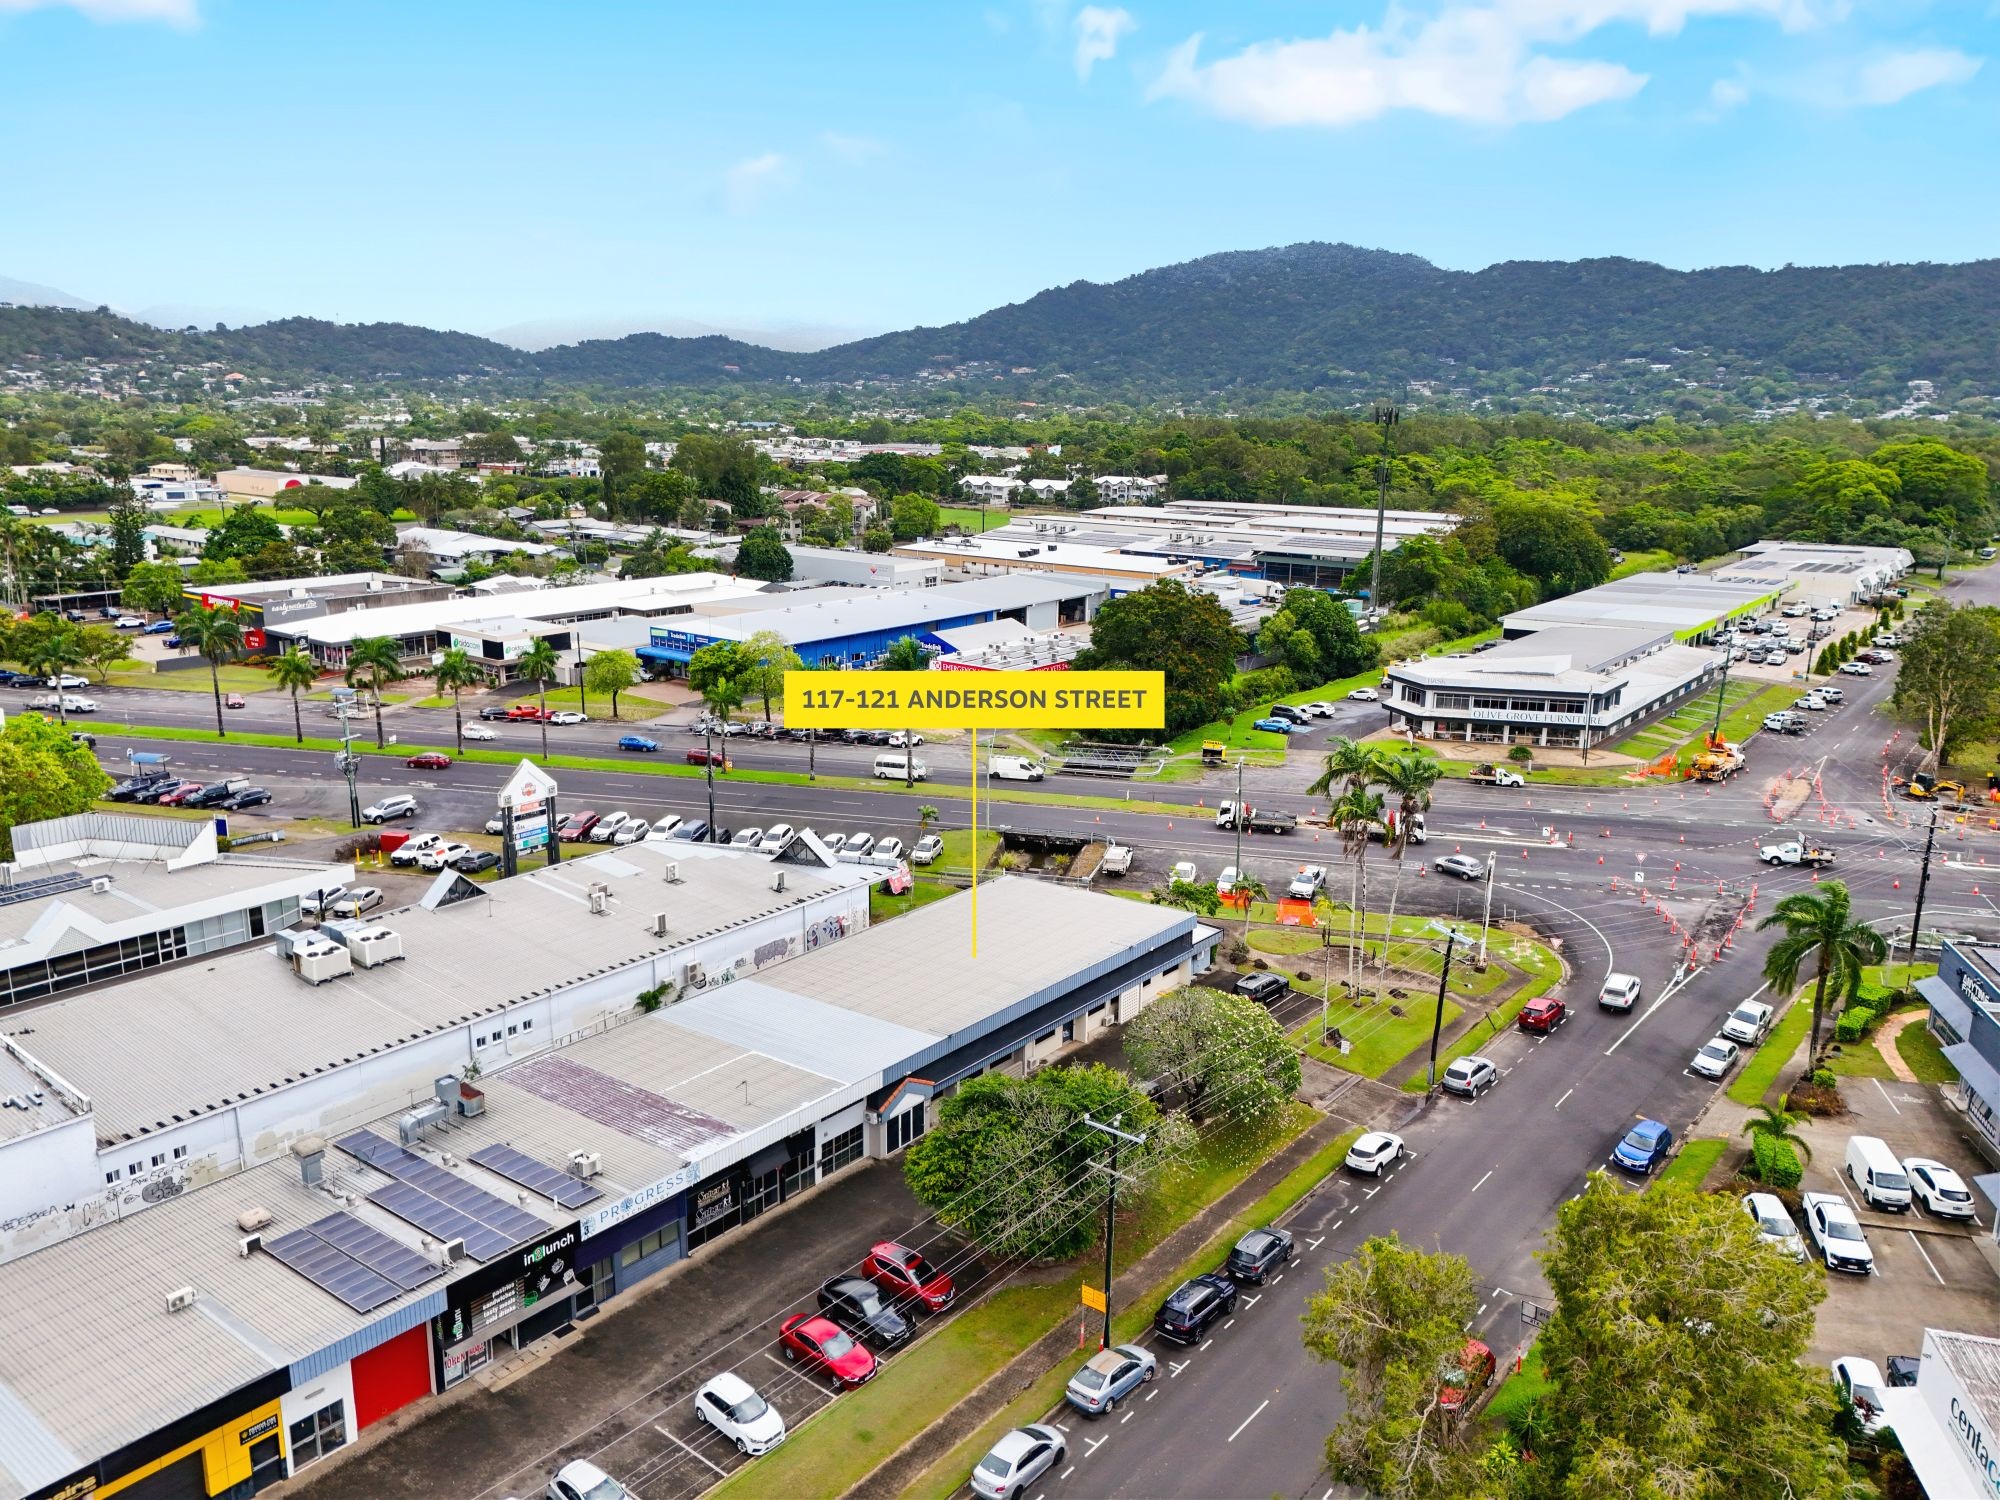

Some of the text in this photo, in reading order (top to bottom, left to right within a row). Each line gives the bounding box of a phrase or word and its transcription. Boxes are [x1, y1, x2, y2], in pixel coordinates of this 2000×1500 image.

[1473, 710, 1504, 720] OLIVE
[1506, 712, 1541, 722] GROVE
[616, 1192, 670, 1222] PSYCHOLOGY
[584, 1225, 590, 1236] 3
[523, 1232, 574, 1267] in2lunch
[482, 1290, 516, 1311] sandwiches
[483, 1297, 516, 1318] tasty meals
[485, 1305, 516, 1325] cold drinks
